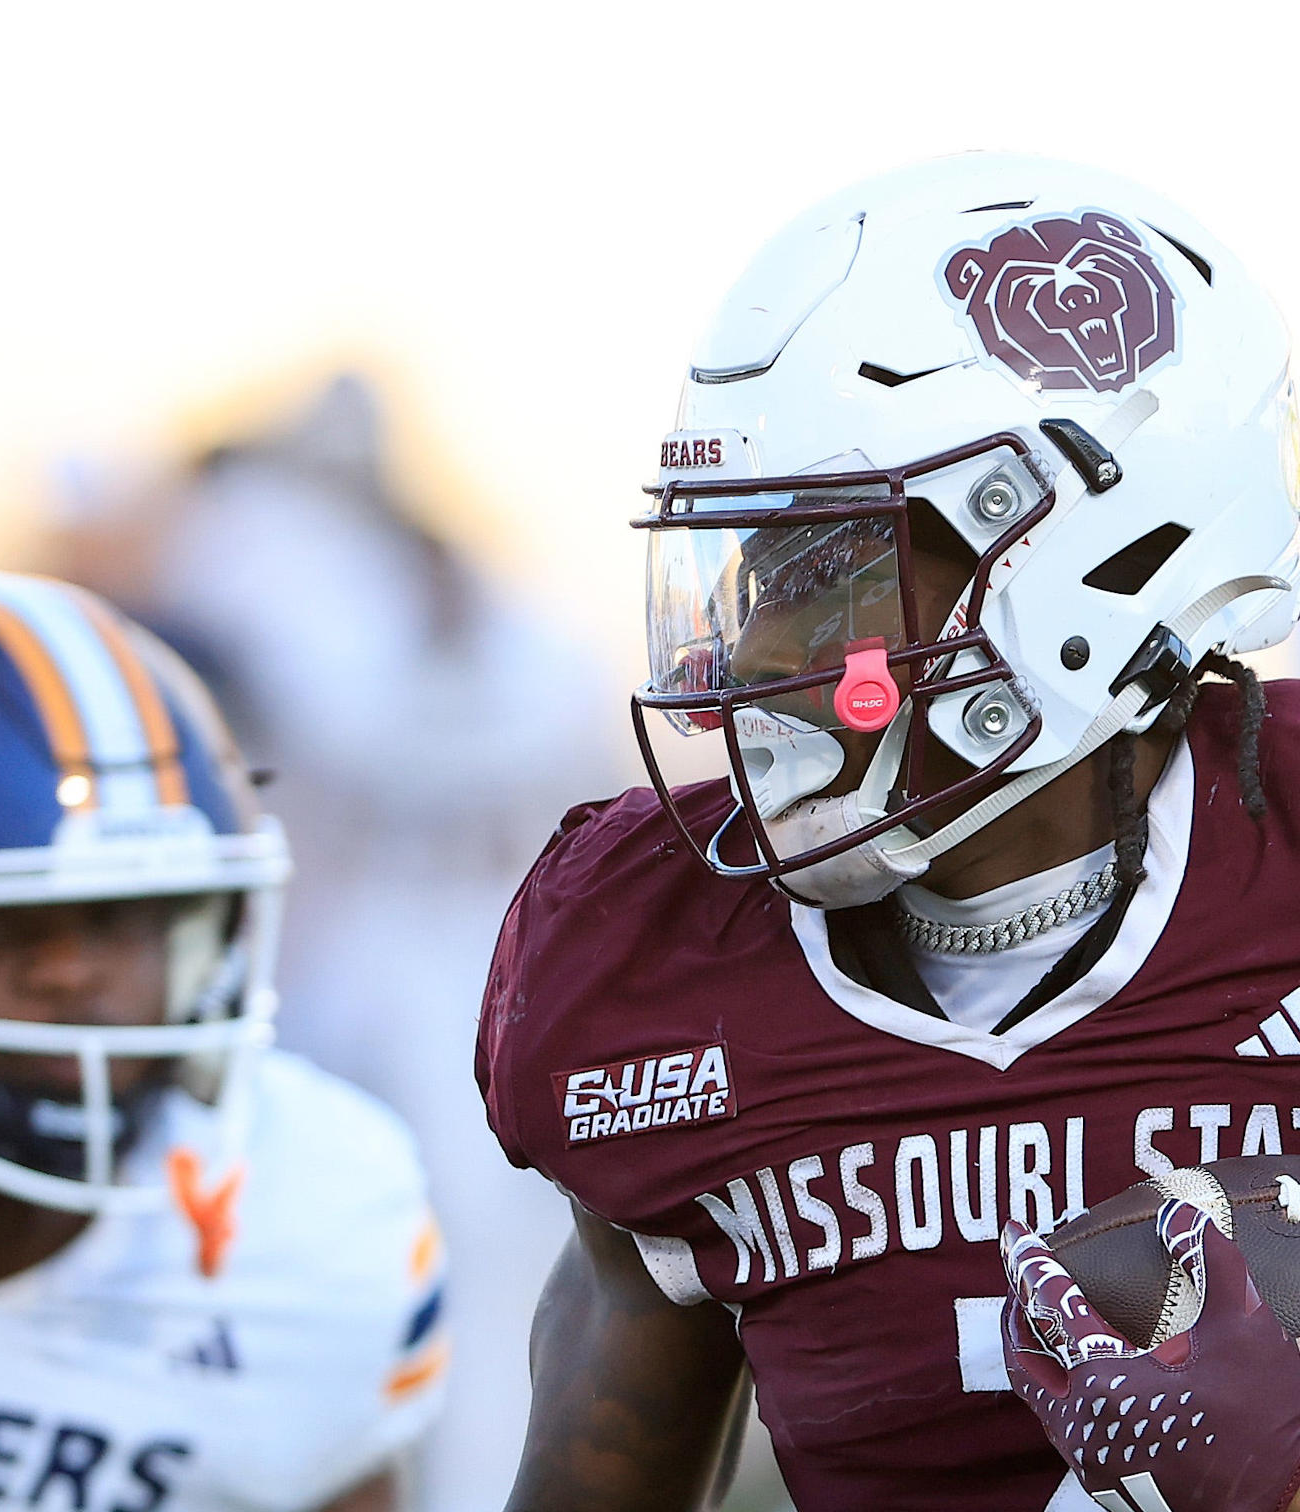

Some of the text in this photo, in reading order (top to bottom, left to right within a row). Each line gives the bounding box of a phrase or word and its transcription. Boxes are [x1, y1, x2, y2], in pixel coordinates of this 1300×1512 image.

[660, 438, 722, 467] BEARS
[569, 1089, 729, 1142] GRADUATE
[694, 1117, 1087, 1285] MISSOURI
